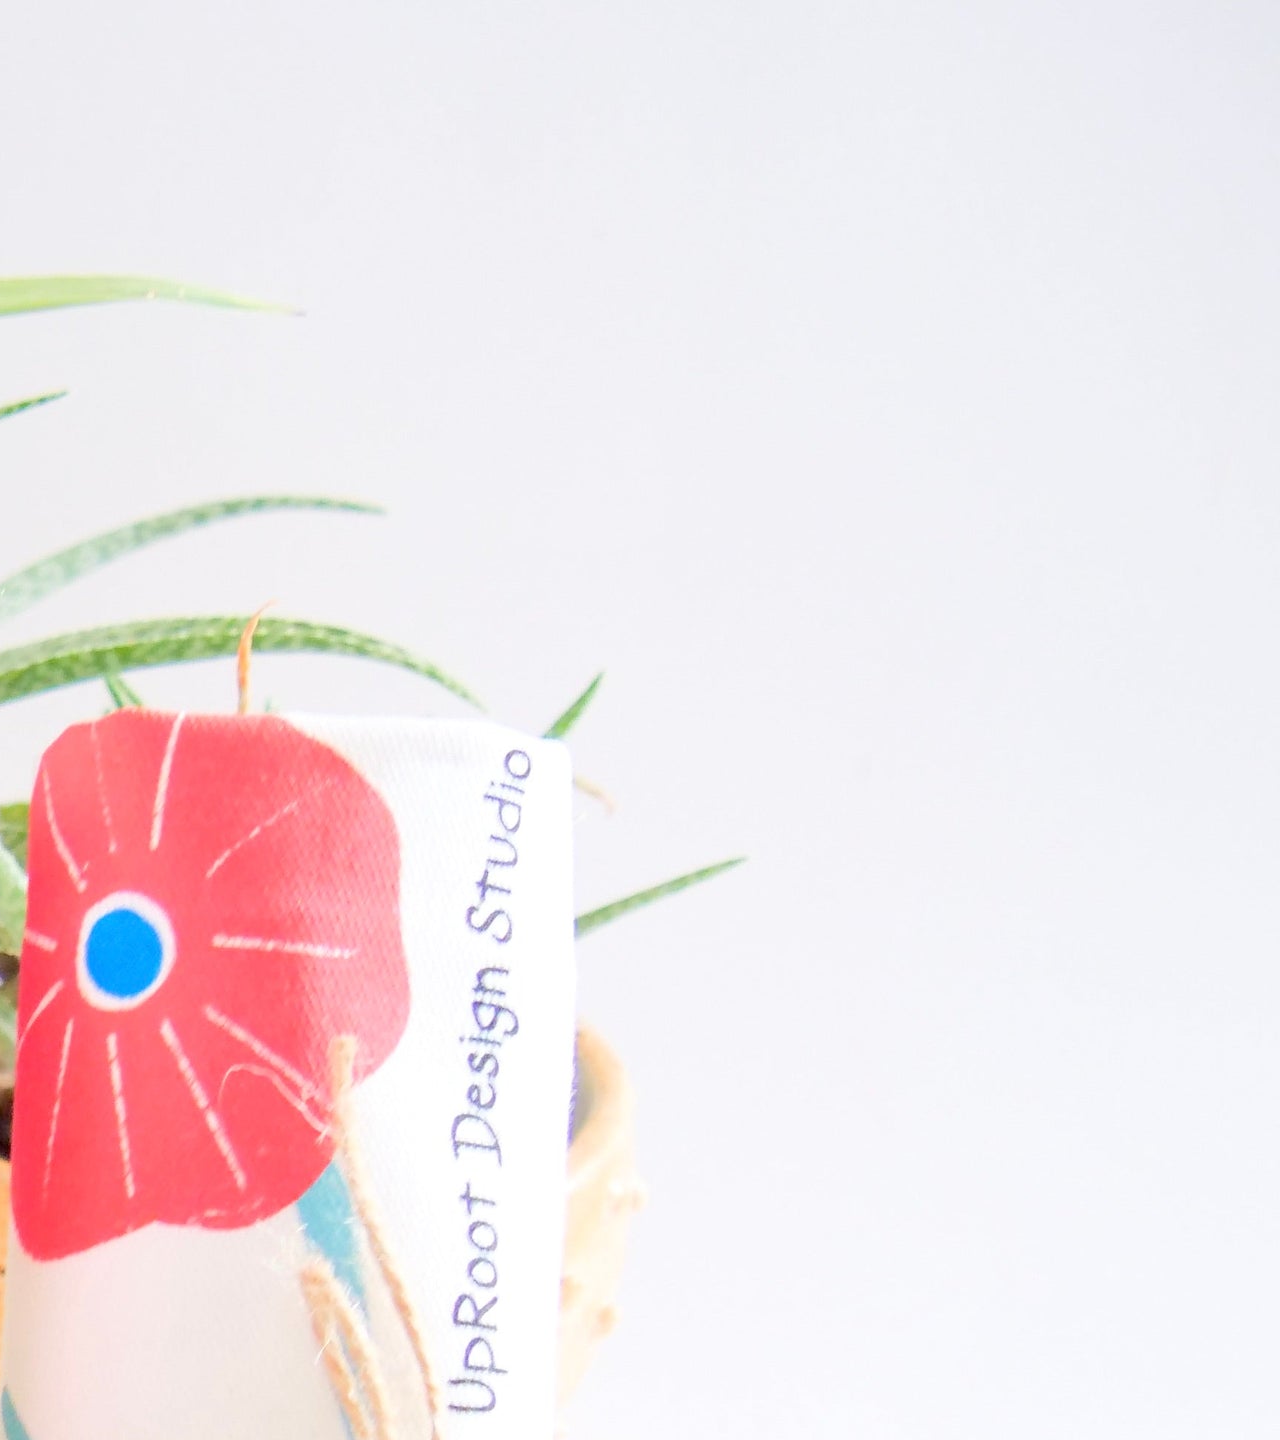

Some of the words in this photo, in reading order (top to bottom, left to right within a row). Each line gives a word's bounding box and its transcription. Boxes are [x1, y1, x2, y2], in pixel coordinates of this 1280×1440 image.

[466, 748, 532, 945] Studio
[450, 965, 518, 1167] Design
[447, 1181, 508, 1414] UpRoot
